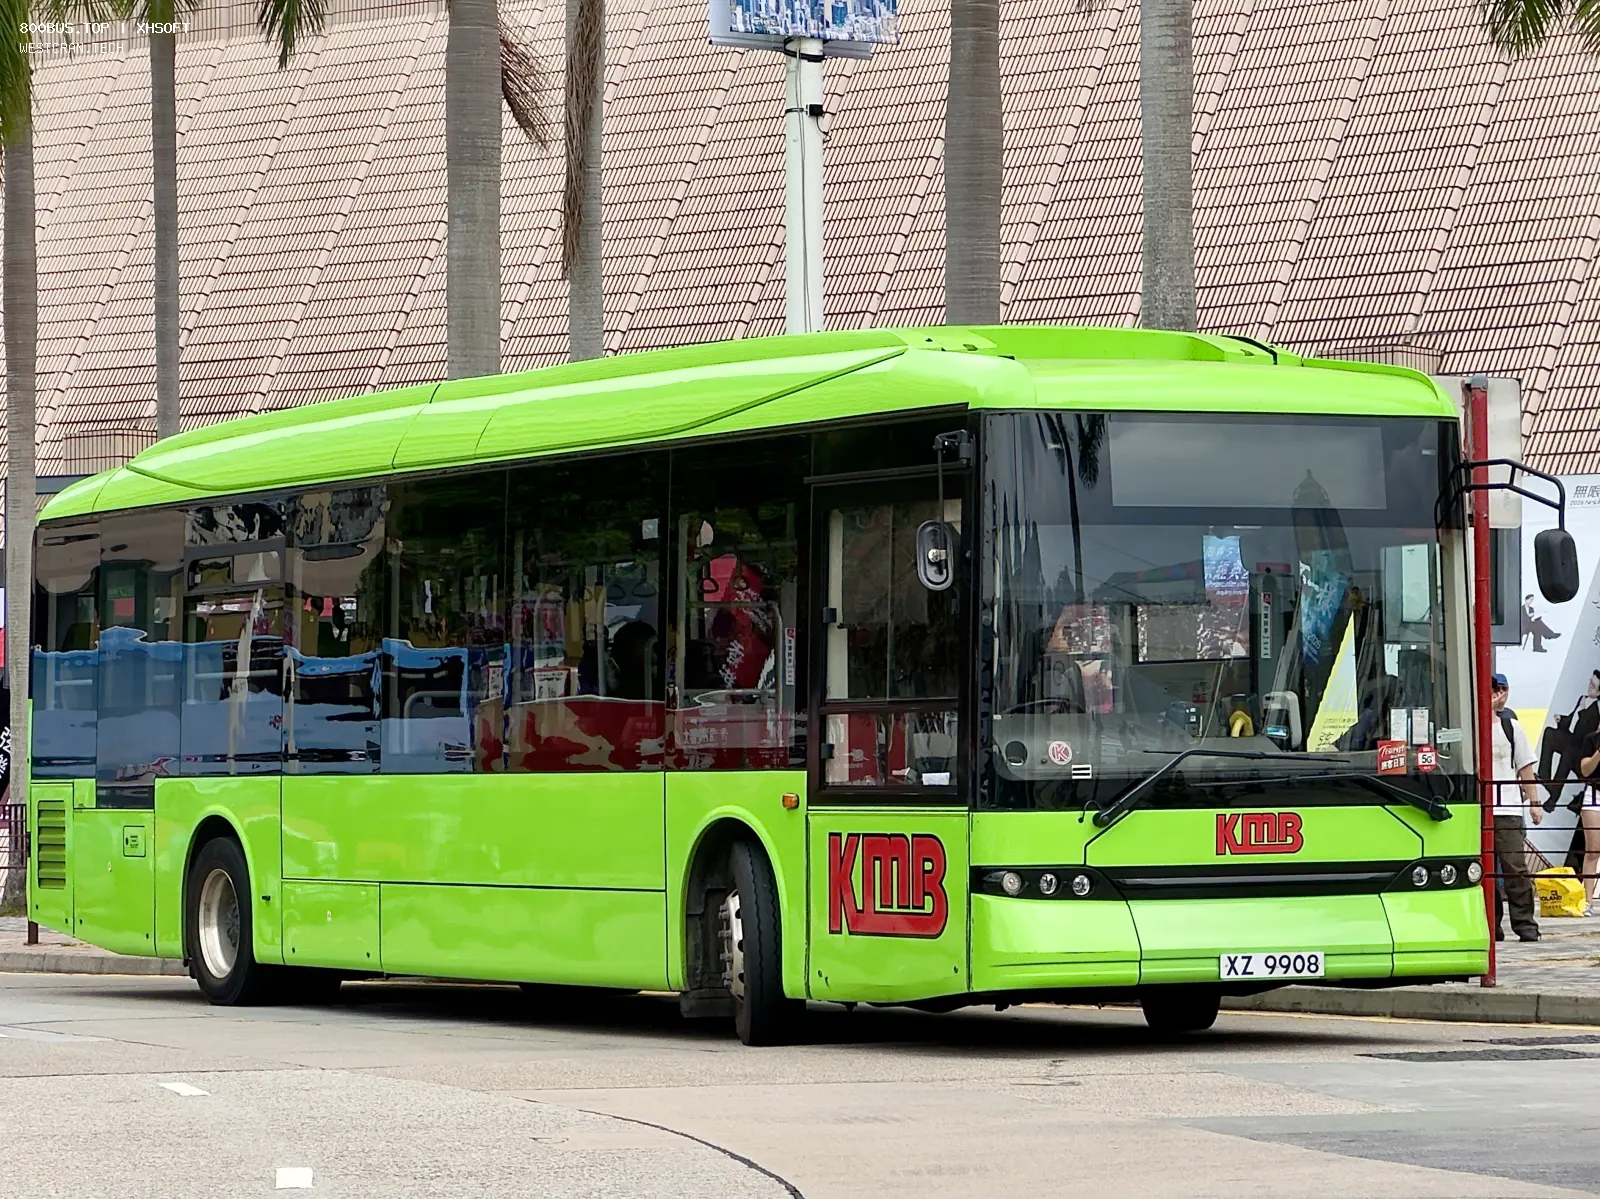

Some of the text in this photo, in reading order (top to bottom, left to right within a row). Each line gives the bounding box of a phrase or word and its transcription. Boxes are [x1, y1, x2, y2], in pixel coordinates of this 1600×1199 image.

[1215, 811, 1304, 856] KMB
[828, 831, 949, 940] KMB
[1226, 954, 1319, 976] XZ 9908
